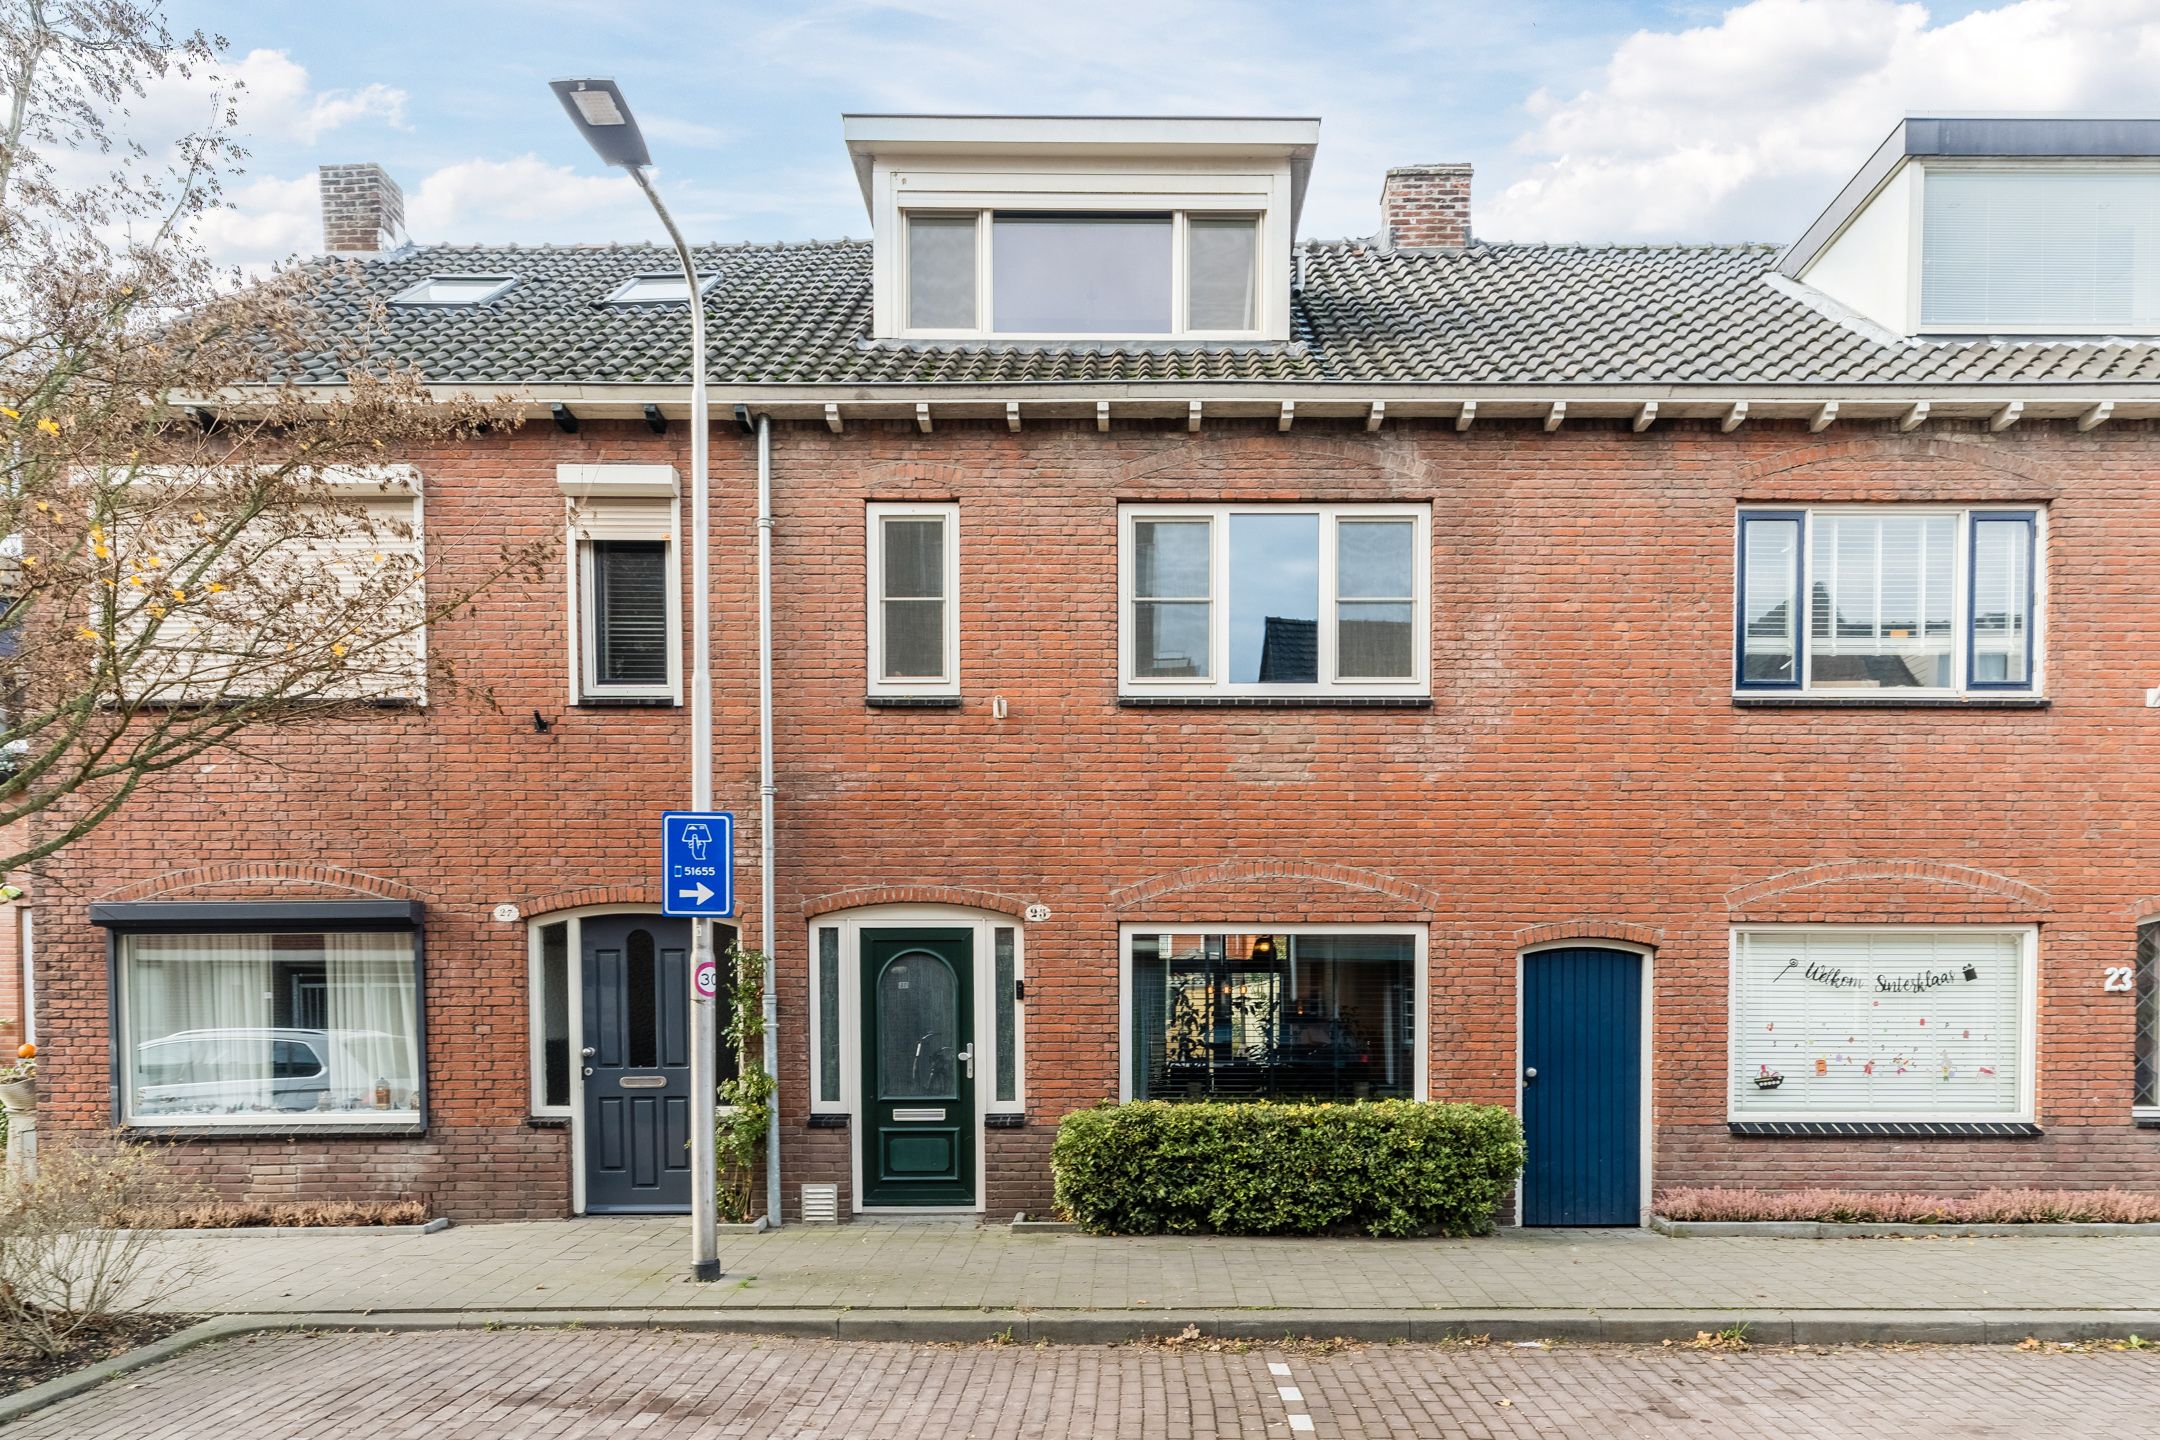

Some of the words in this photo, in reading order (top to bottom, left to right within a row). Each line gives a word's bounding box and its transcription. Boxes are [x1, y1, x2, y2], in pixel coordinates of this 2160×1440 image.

[684, 866, 716, 876] 51655
[500, 909, 513, 917] 27
[1805, 961, 1864, 989] Welkom
[1875, 969, 1956, 994] Sinterklaas
[2103, 966, 2133, 992] 23
